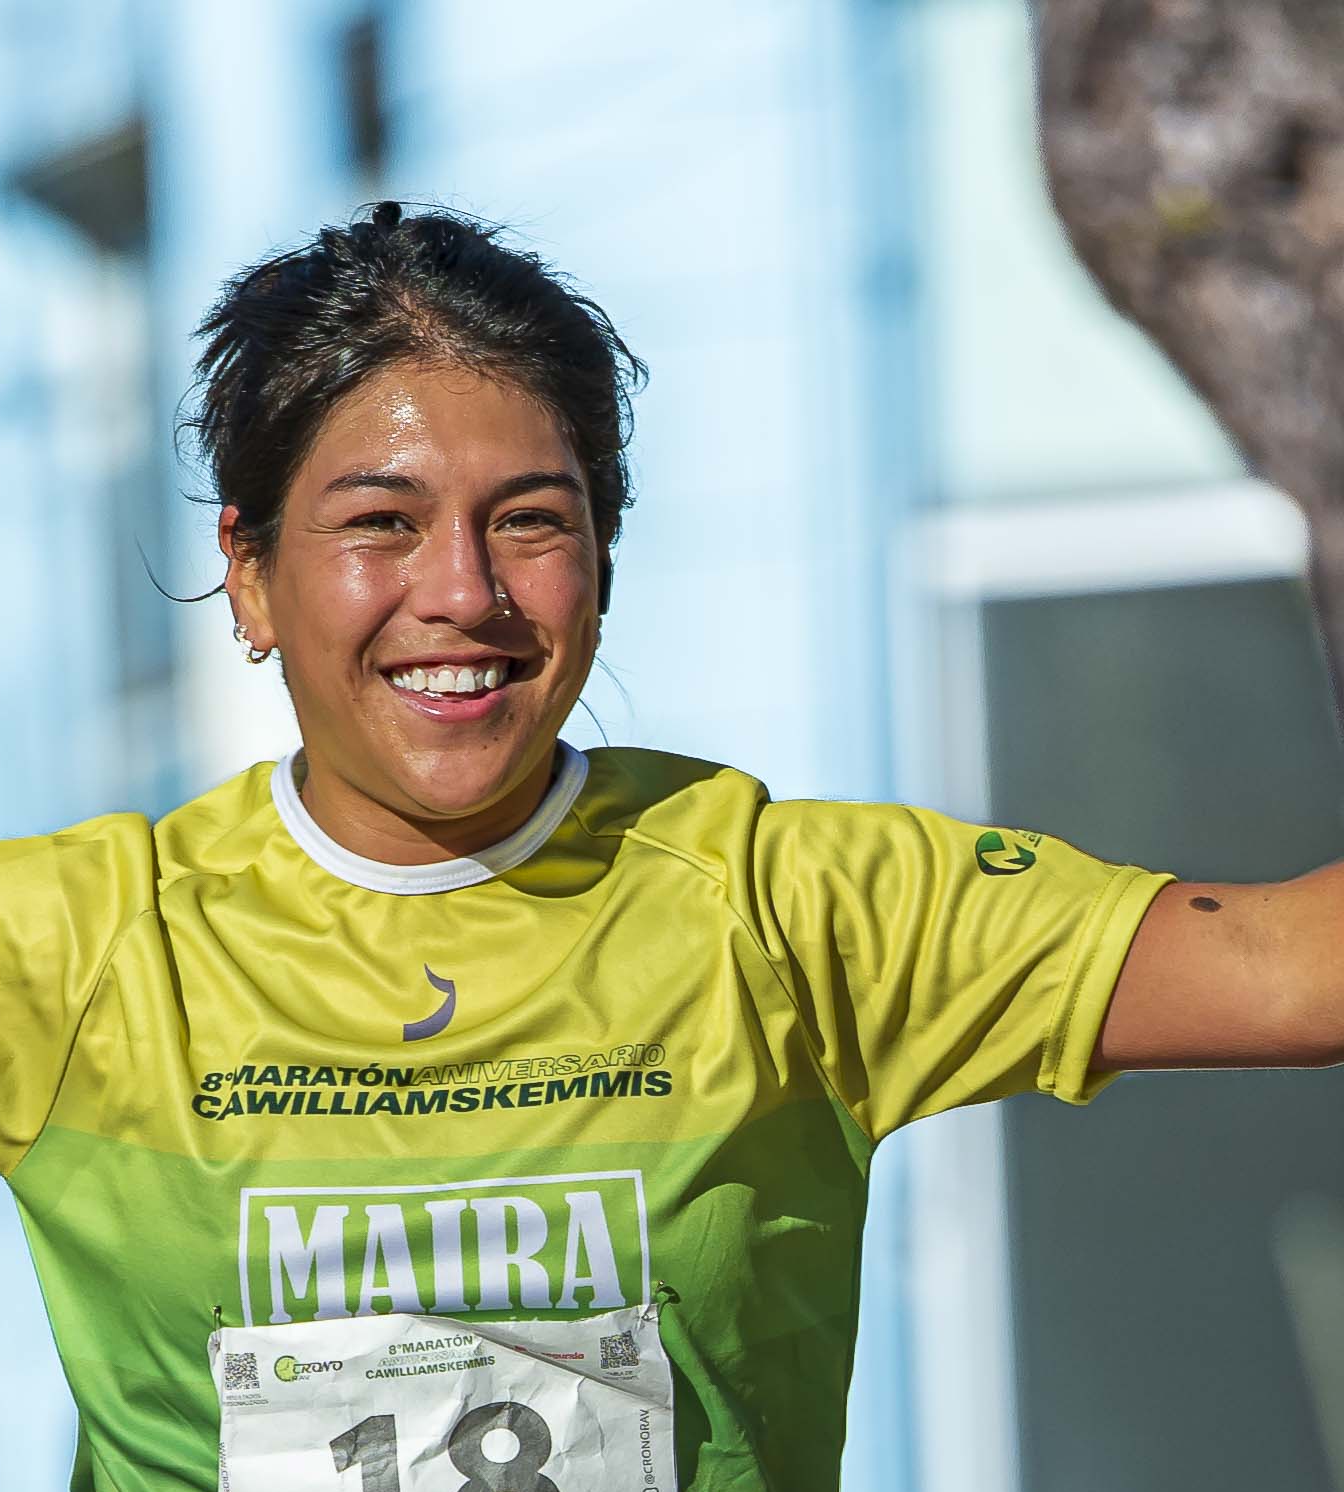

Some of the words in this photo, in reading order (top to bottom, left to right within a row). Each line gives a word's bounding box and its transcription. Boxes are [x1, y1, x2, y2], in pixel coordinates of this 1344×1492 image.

[191, 1070, 673, 1121] CAWILLIAMSKEMMIS
[264, 1190, 626, 1323] MAIRA
[365, 1355, 496, 1380] CAWILLIAMSKEMMIS
[639, 1408, 656, 1485] @CRONORAV
